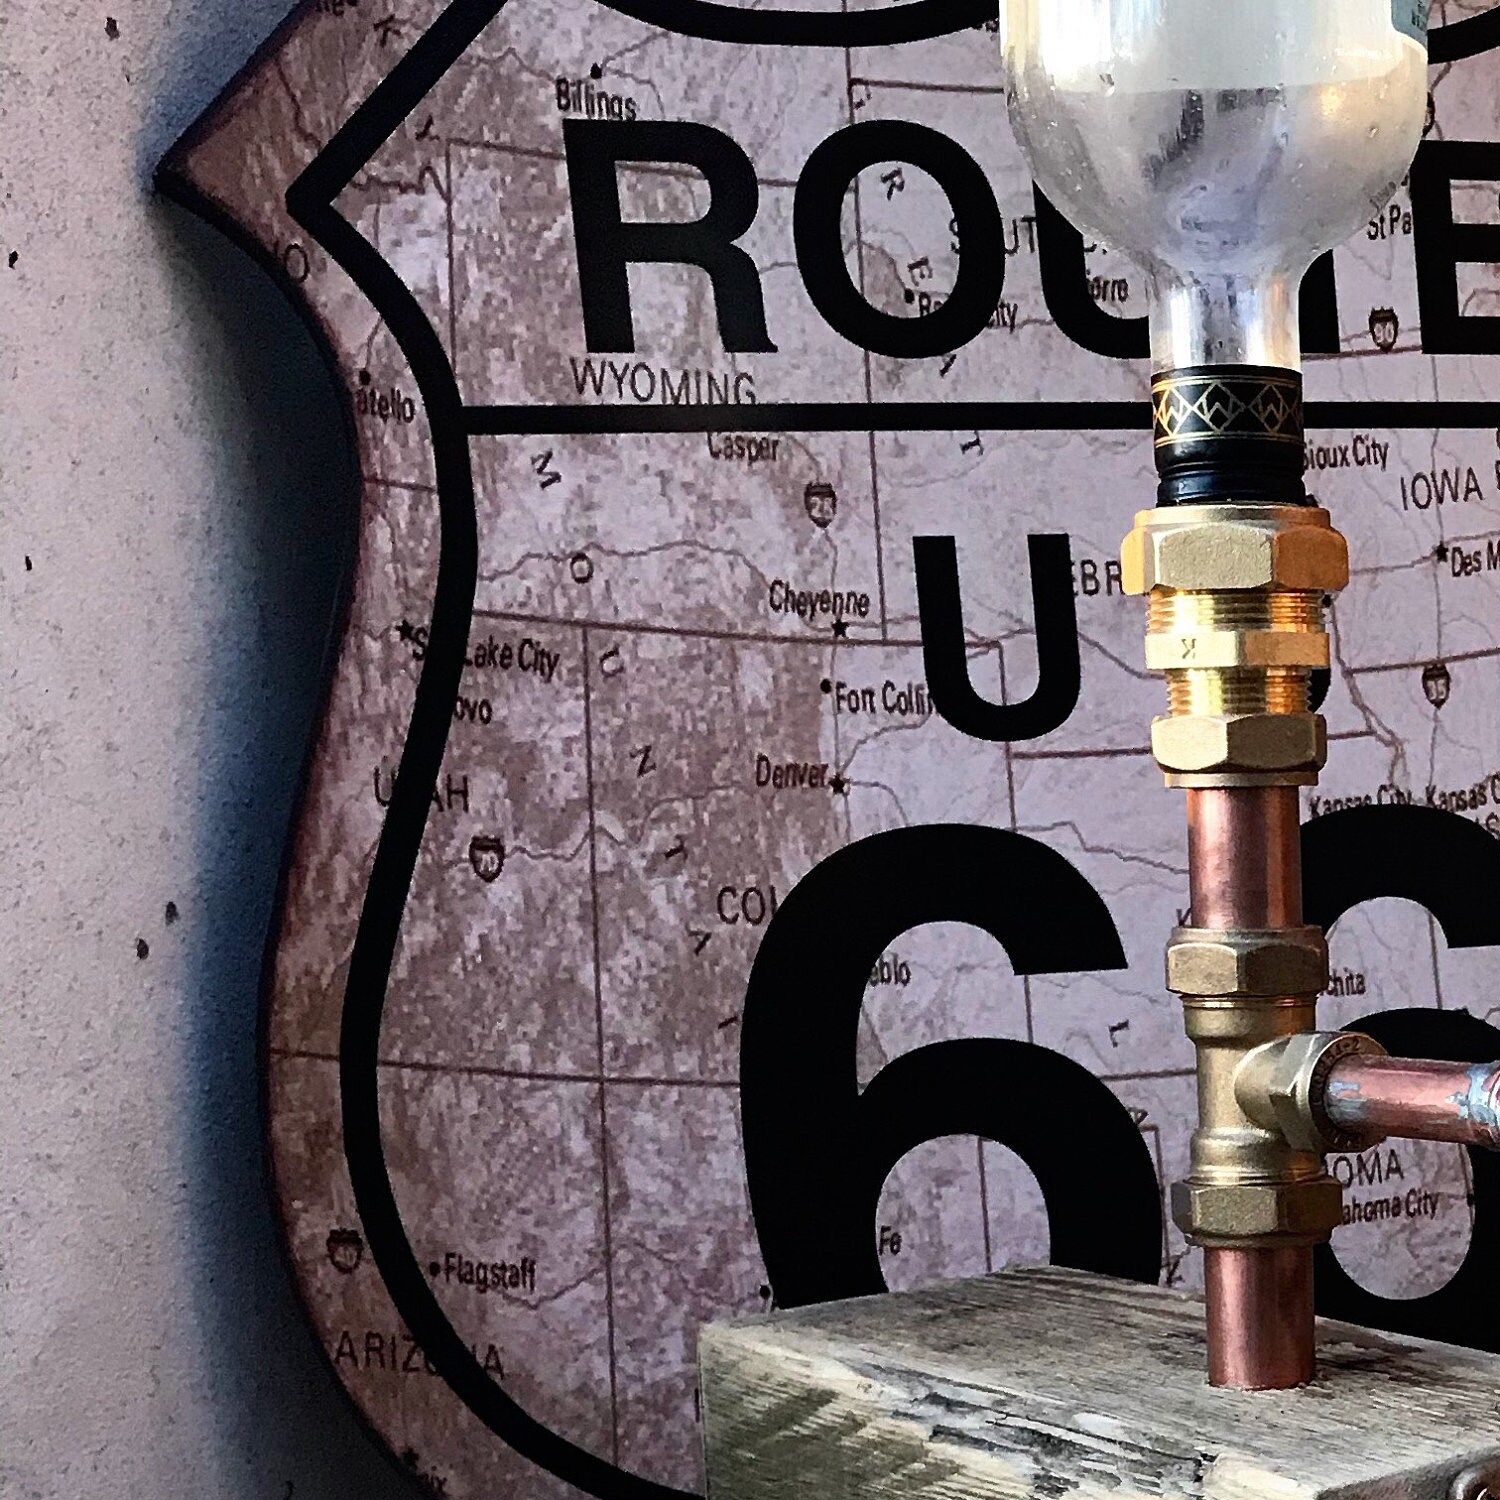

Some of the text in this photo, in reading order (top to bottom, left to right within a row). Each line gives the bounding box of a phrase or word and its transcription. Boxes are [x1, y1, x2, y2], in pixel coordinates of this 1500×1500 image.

[556, 78, 637, 121] Billings
[1366, 204, 1413, 241] St Pa
[569, 357, 756, 405] WYOMING
[707, 432, 780, 467] Casper
[1352, 433, 1390, 473] City
[1400, 466, 1484, 511] IOWA
[1451, 545, 1482, 578] Des
[769, 579, 870, 621] Cheyenne
[517, 638, 561, 684] City
[452, 696, 493, 724] ovo
[755, 754, 827, 793] Denver
[1425, 783, 1488, 813] Kansas
[868, 951, 911, 987] eblo
[1326, 967, 1366, 998] chita
[1342, 1187, 1439, 1225] ahoma City
[878, 1225, 902, 1256] Fe
[444, 1252, 537, 1295] Flagstaff
[334, 1329, 505, 1381] ARIZA
